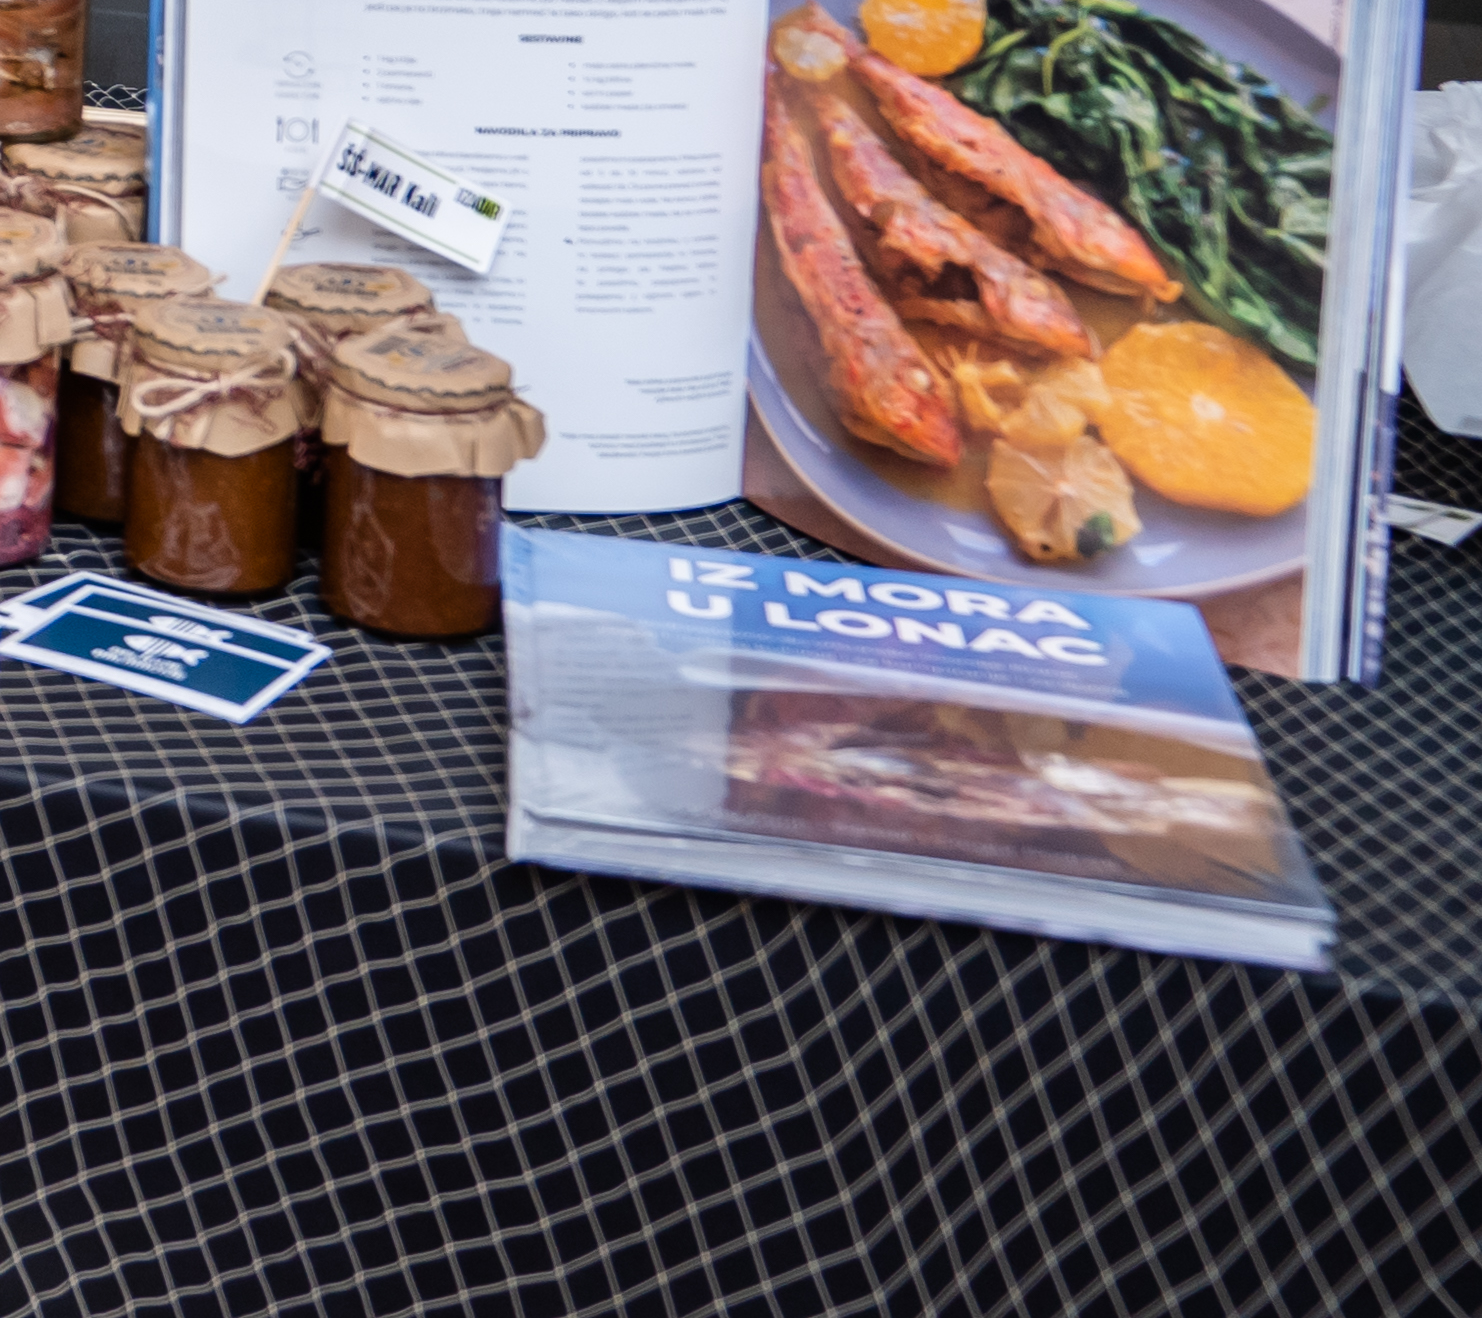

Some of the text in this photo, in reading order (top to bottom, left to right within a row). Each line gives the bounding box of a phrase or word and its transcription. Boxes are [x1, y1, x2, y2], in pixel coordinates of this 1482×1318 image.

[401, 180, 441, 220] Kali
[666, 589, 732, 621] U
[763, 601, 1111, 666] LONAC
[667, 557, 1093, 632] IZ MORA
